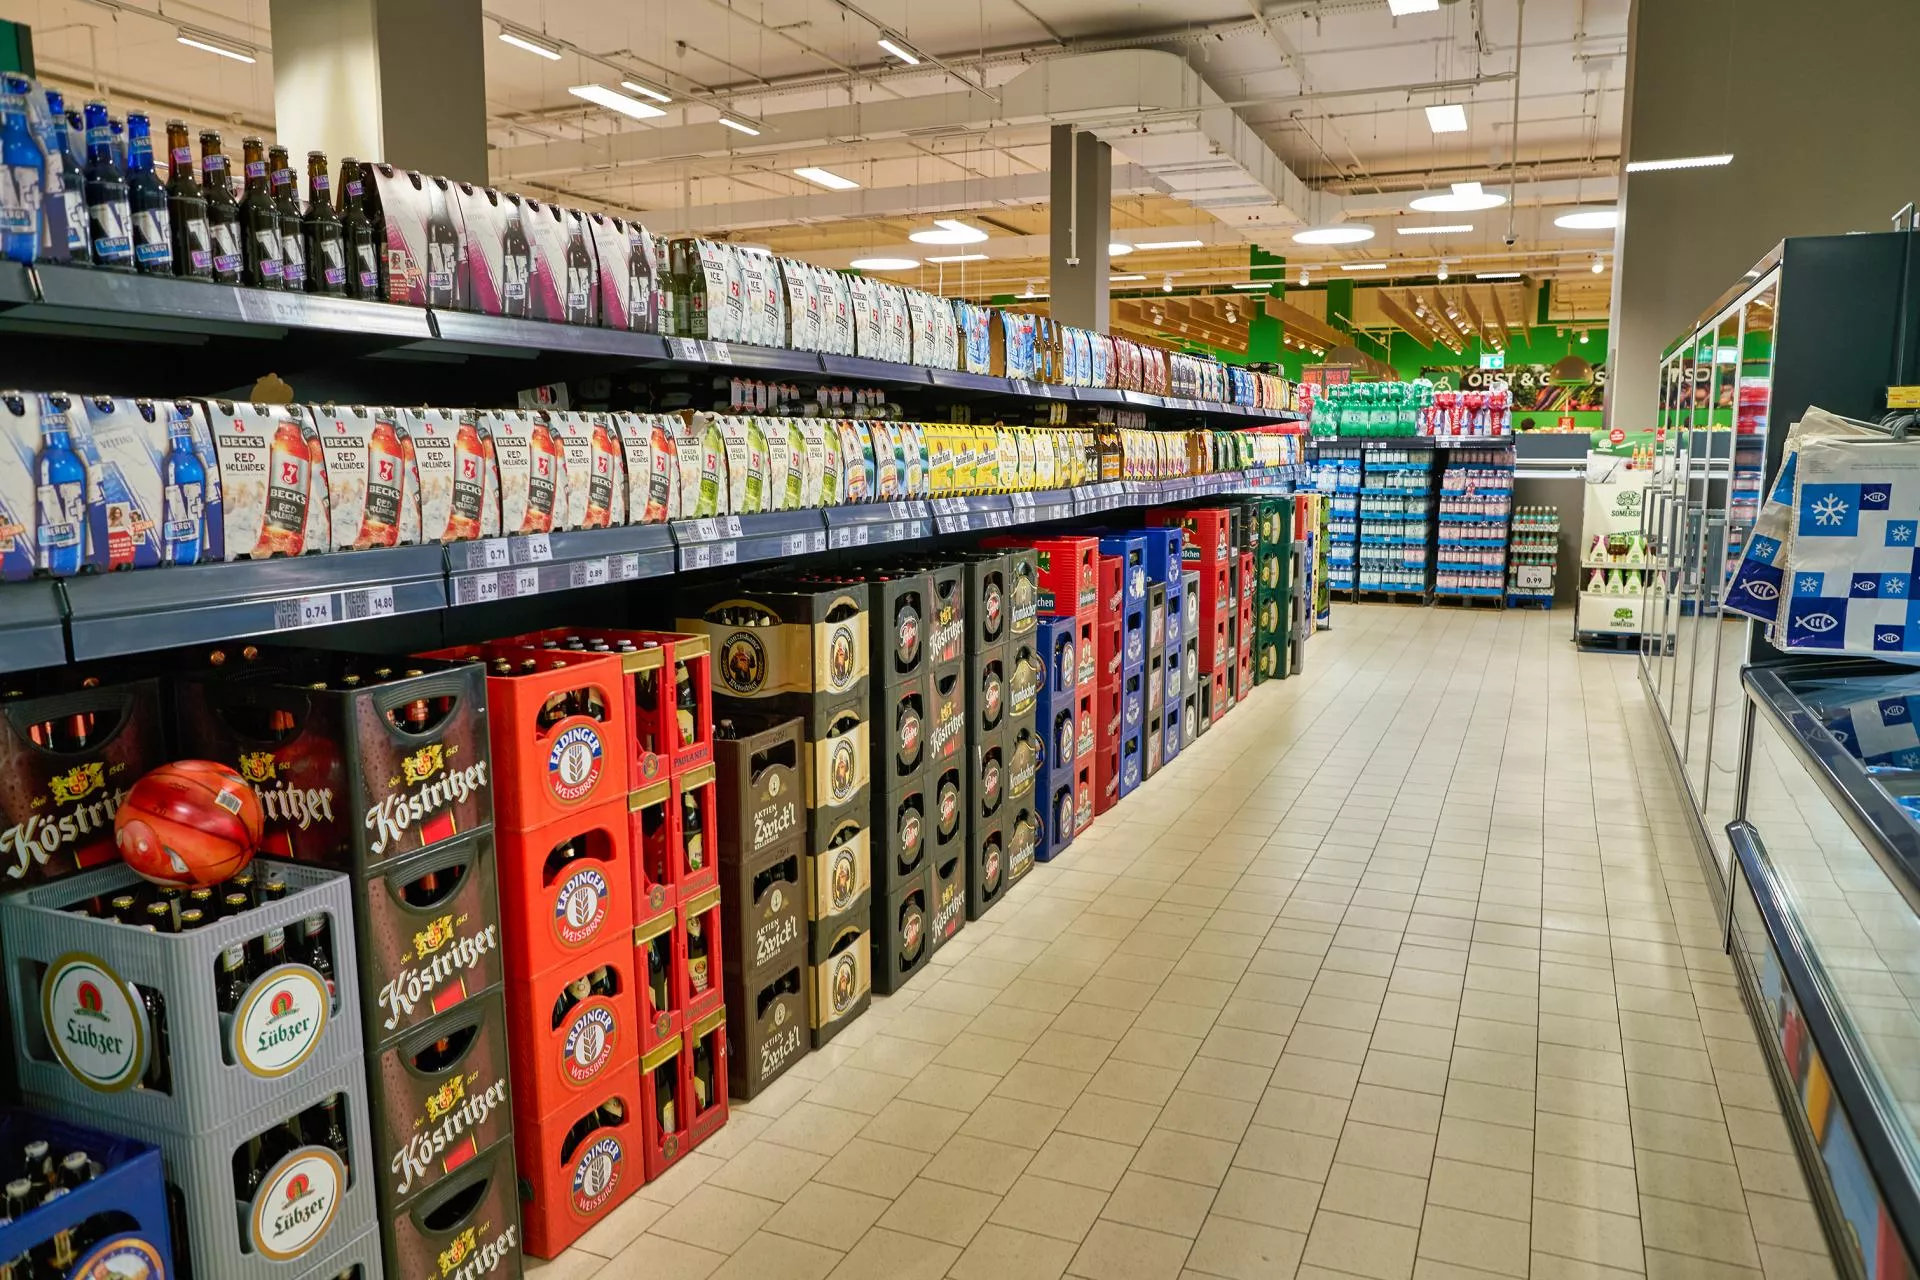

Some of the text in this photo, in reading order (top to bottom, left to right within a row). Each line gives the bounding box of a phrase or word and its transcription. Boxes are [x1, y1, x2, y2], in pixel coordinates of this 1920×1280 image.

[710, 272, 721, 281] ICE
[1468, 372, 1517, 387] OBST
[1520, 372, 1534, 387] &
[221, 437, 265, 448] BECK'S
[325, 437, 363, 448] BECK'S
[417, 439, 450, 447] BECK'S
[498, 438, 526, 446] BECK'S
[234, 452, 256, 462] RED
[337, 452, 356, 462] RED
[427, 452, 444, 460] RED
[508, 451, 521, 459] RED
[572, 449, 584, 457] RED
[225, 463, 265, 472] HOLUNDER
[330, 462, 365, 470] HOLUNDER
[270, 488, 307, 505] BECK'S
[369, 485, 401, 500] BECK'S
[278, 502, 297, 514] RED
[376, 498, 392, 509] RED
[43, 524, 73, 537] ENERGY
[167, 521, 192, 533] ENERGY
[490, 550, 506, 560] 0.71
[532, 544, 548, 554] 4.26
[589, 569, 603, 578] 0.89
[481, 583, 497, 594] 0.89
[520, 577, 535, 588] 17.80
[344, 591, 368, 603] MEHR-
[461, 591, 477, 604] WEG
[501, 585, 516, 597] WEG
[274, 598, 300, 614] MEHR-
[374, 597, 393, 609] 14.80
[305, 605, 328, 619] 0.74
[348, 604, 367, 618] WEG
[279, 615, 299, 629] WEG
[929, 619, 965, 662] Köstritzer
[930, 711, 965, 759] Köstritzer
[550, 728, 601, 764] ERDINGER
[254, 780, 335, 831] ritzer
[365, 760, 488, 855] Köstritzer
[754, 804, 777, 821] AKTIEN
[0, 787, 124, 879] Köstrit
[556, 871, 608, 911] ERDINGER
[931, 888, 965, 944] Köstritzer
[757, 918, 779, 938] AKTIEN
[379, 924, 497, 1030] Köstritzer
[257, 1015, 311, 1054] Lübzer
[565, 1009, 615, 1052] ERDINGER
[65, 1019, 124, 1056] Lübzer
[760, 1032, 784, 1050] AKTIEN
[391, 1078, 507, 1195] Köstritzer
[574, 1138, 622, 1185] ERDINGER
[272, 1194, 326, 1239] Lübzer
